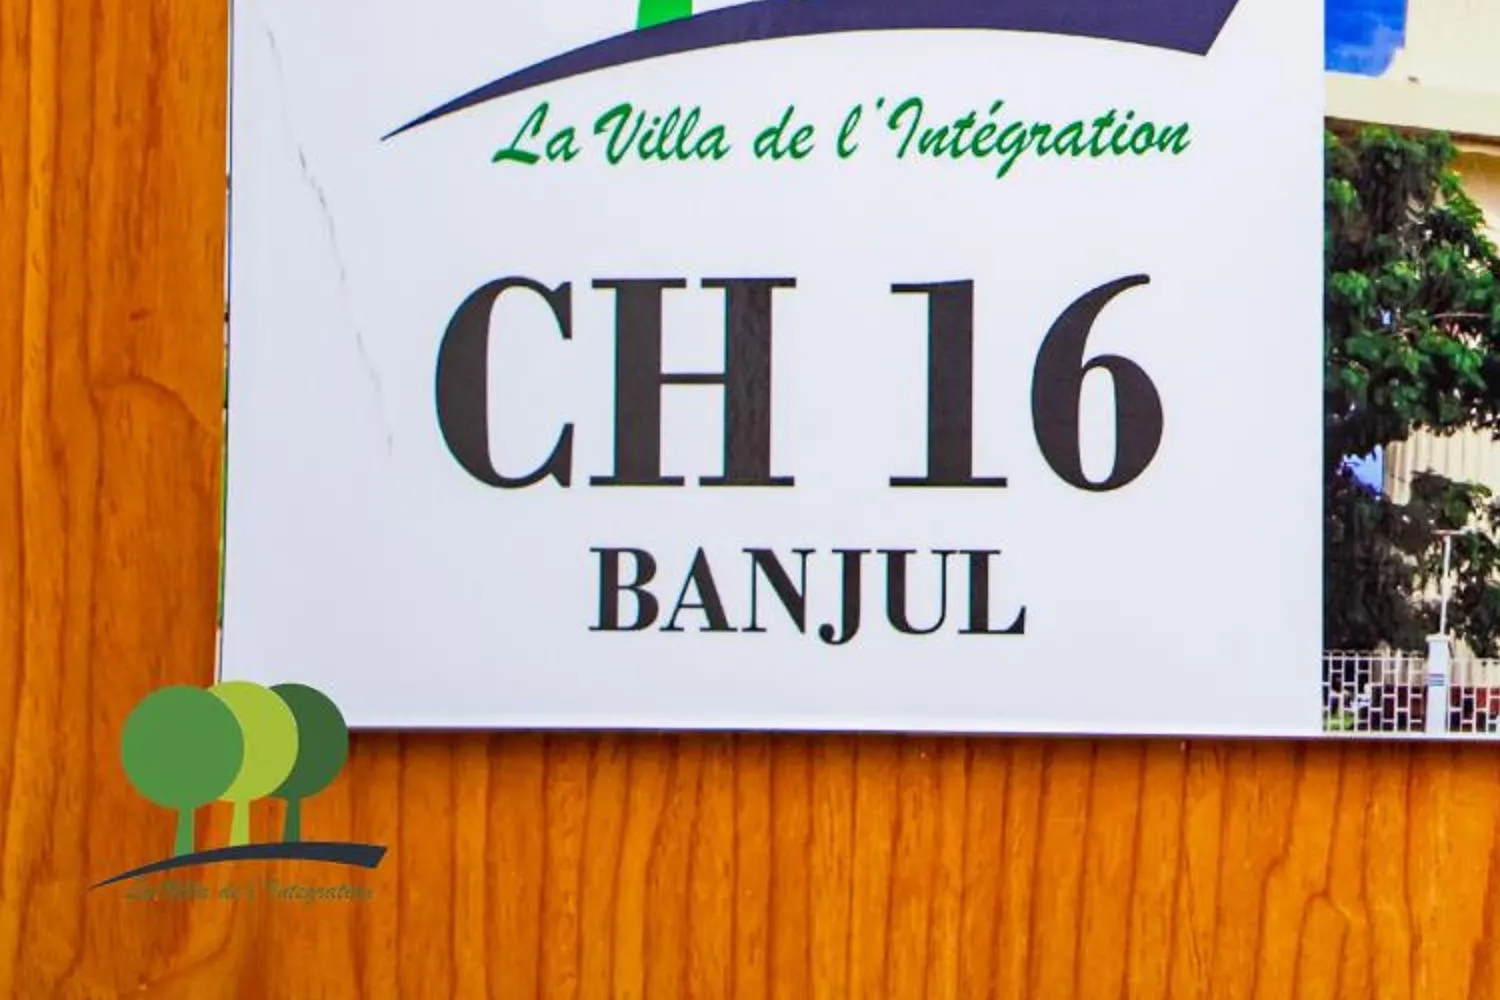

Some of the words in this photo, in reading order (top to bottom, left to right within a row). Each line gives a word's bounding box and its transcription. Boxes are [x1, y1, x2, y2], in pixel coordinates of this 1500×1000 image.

[491, 98, 580, 167] La
[591, 101, 731, 166] Villa
[749, 103, 815, 162] de
[435, 277, 797, 489] CH
[889, 274, 1164, 493] 16
[589, 547, 1026, 646] BANJUL
